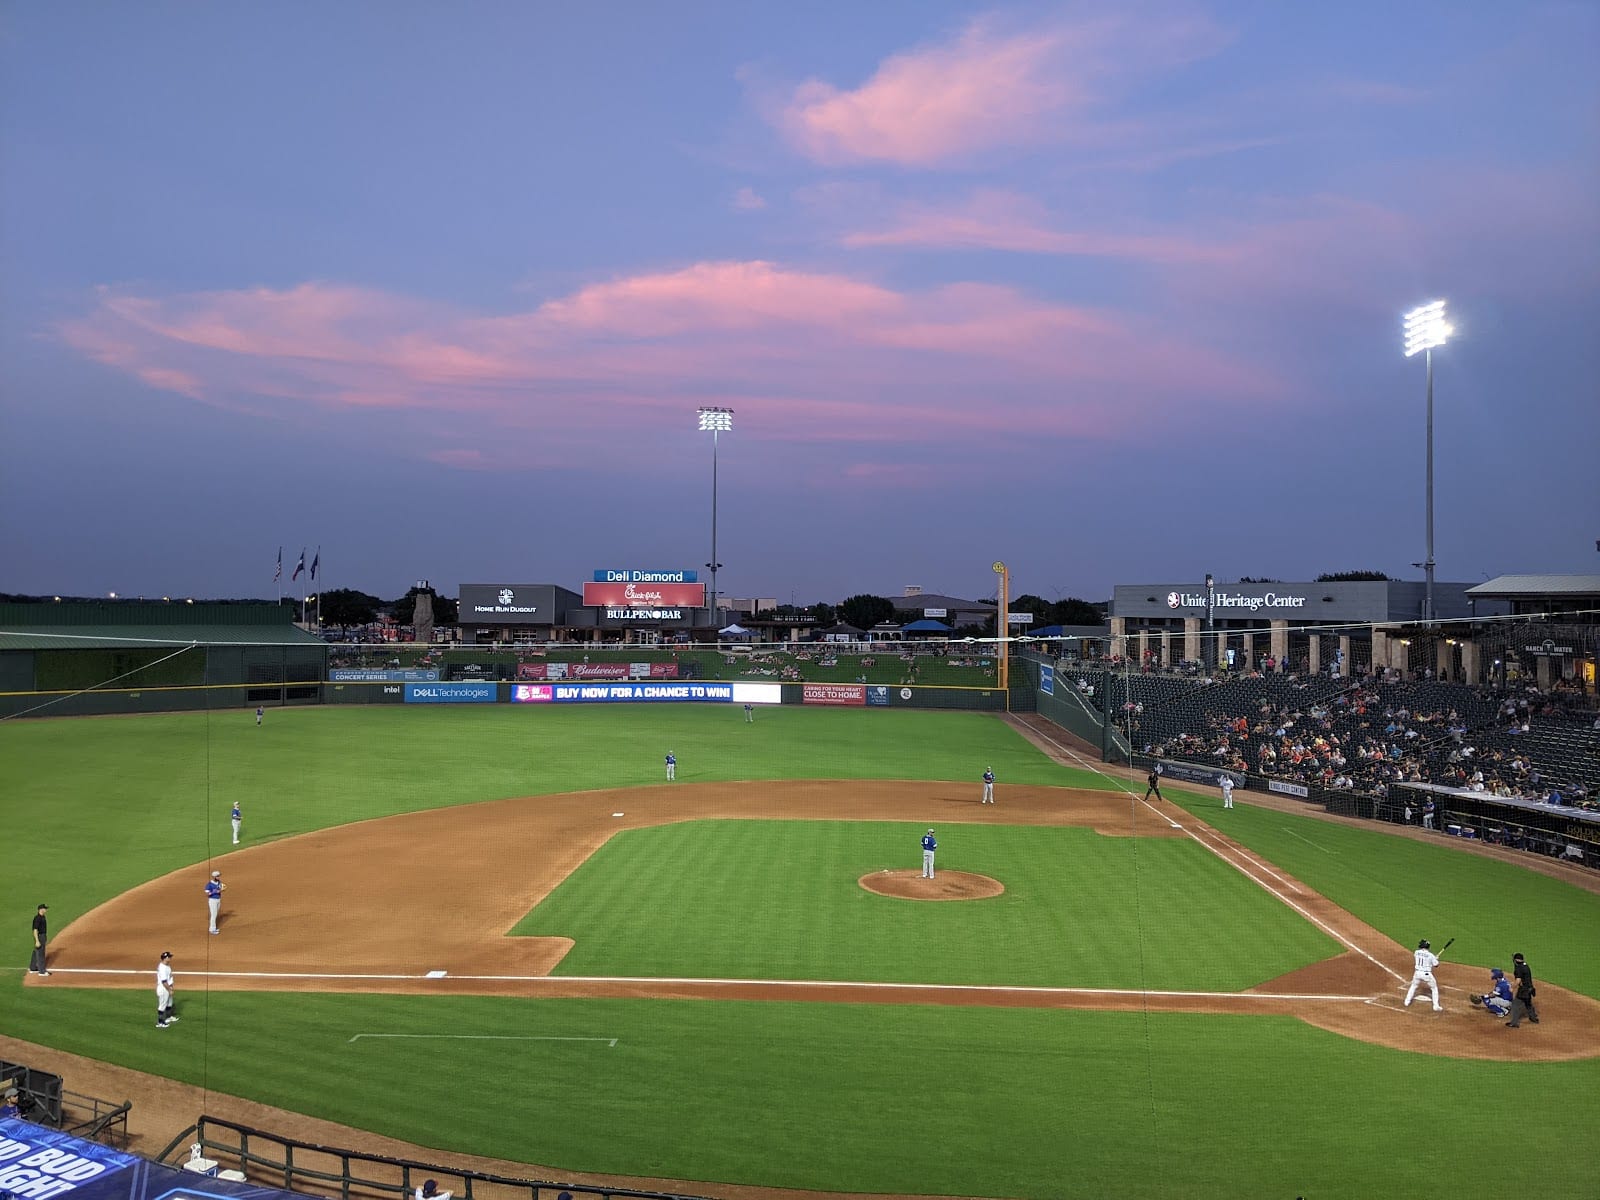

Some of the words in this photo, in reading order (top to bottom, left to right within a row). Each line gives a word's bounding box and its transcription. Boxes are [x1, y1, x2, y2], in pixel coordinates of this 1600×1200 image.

[607, 571, 629, 581] Dell
[633, 570, 683, 582] Diamond
[1217, 593, 1263, 611] Heritage
[1265, 592, 1305, 607] Center
[607, 610, 653, 619] BULLPEN
[661, 610, 681, 619] BAR
[573, 664, 625, 675] Budweiser
[384, 685, 400, 693] intel
[414, 688, 437, 697] DELL
[438, 687, 489, 698] Technologies
[556, 687, 580, 698] BUY
[581, 687, 608, 698] NOW
[611, 687, 632, 698] FOR
[634, 687, 643, 698] A
[644, 687, 689, 697] CHANCE
[690, 687, 704, 697] TO
[705, 687, 730, 698] WIN!
[18, 1148, 106, 1181] BUD
[0, 1164, 78, 1200] IGHT
